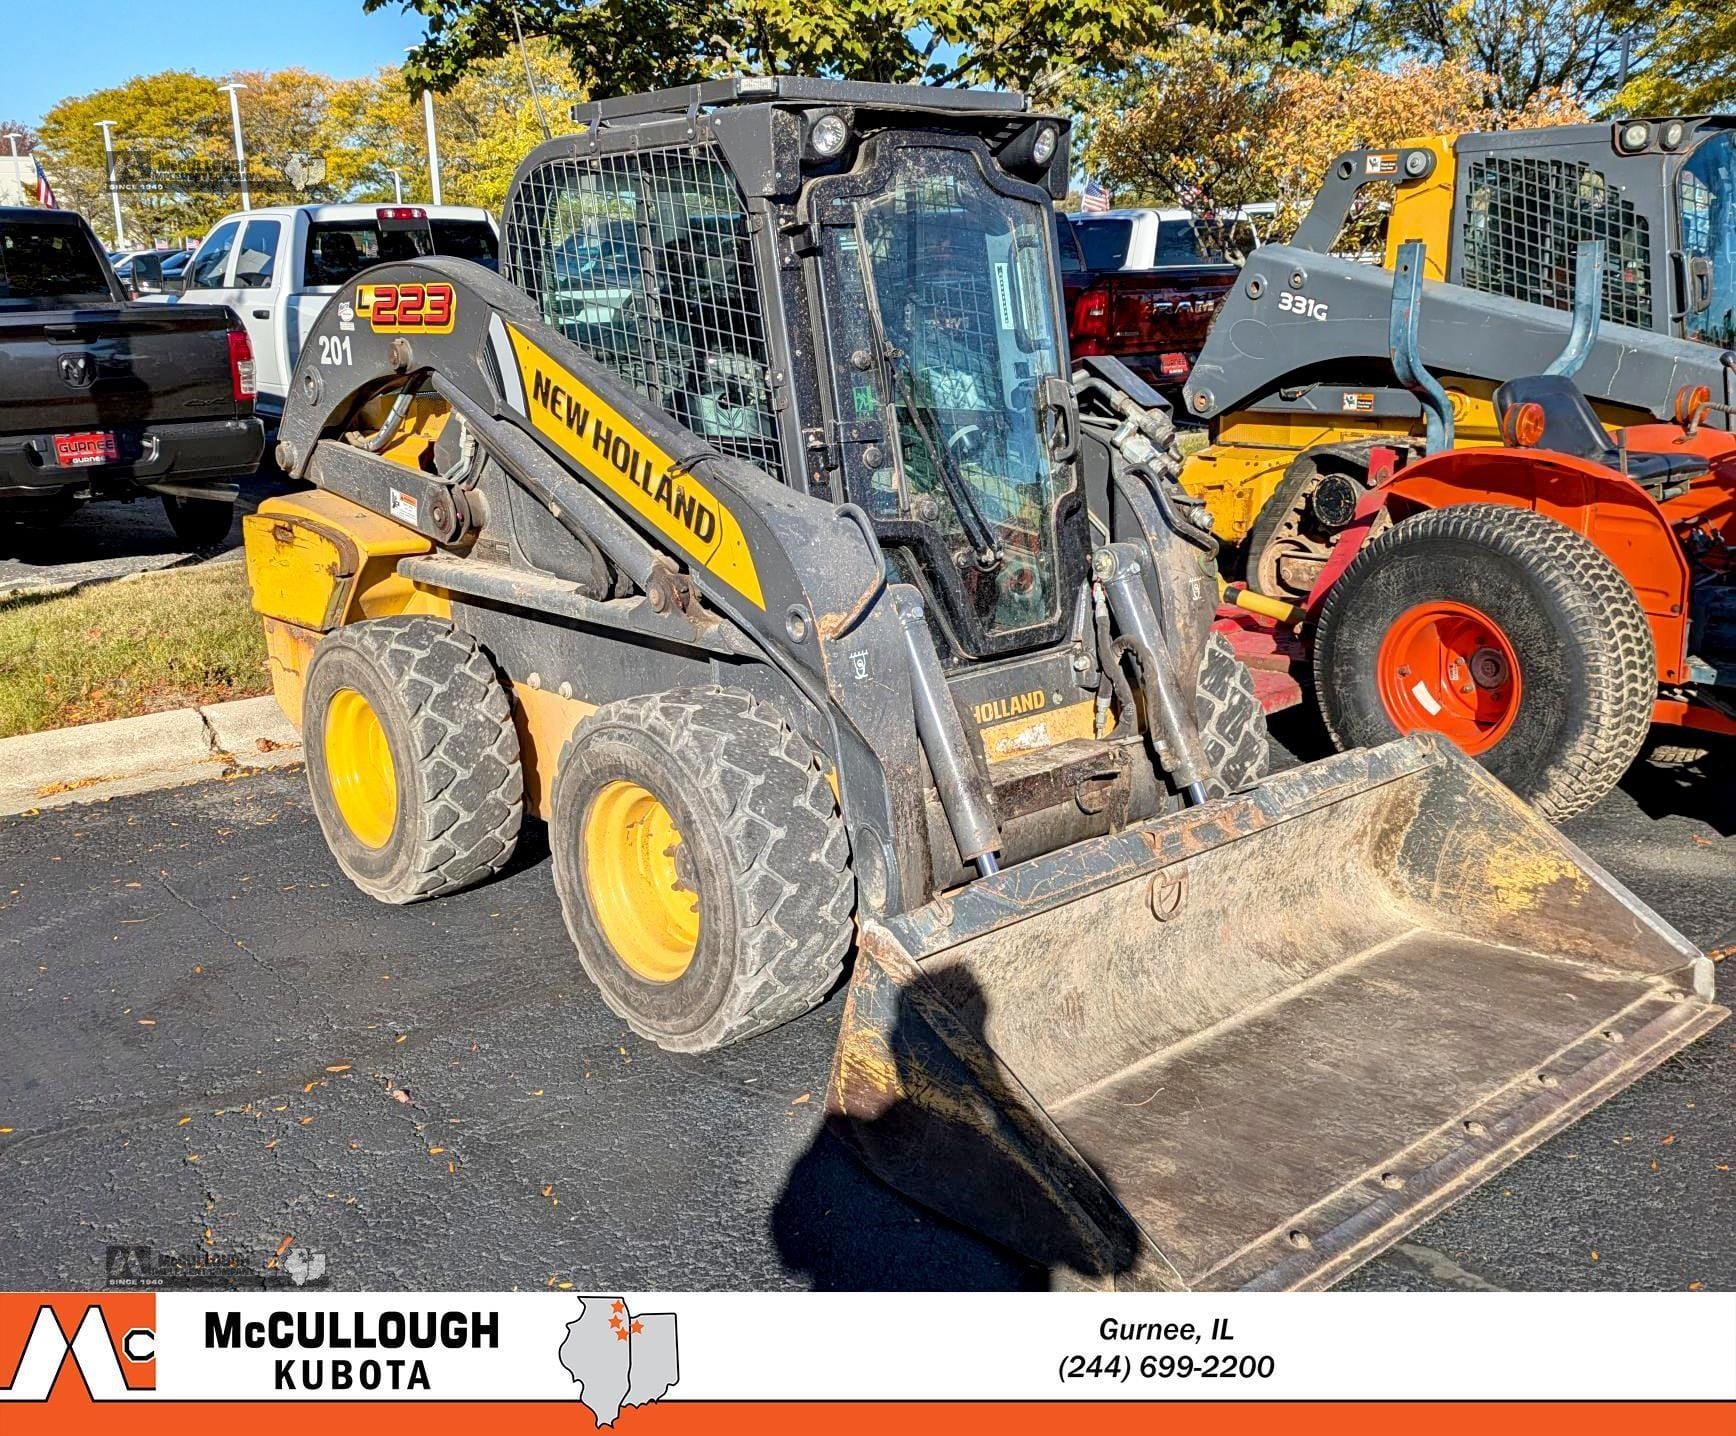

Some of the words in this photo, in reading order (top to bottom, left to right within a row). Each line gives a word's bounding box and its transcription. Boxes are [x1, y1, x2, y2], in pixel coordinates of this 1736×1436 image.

[357, 284, 454, 326] L223
[1153, 301, 1215, 315] RAM
[1278, 291, 1329, 322] 331G
[318, 335, 353, 366] 201
[59, 440, 114, 453] GURNEE
[533, 368, 590, 438] NEW
[592, 417, 717, 544] HOLLAND
